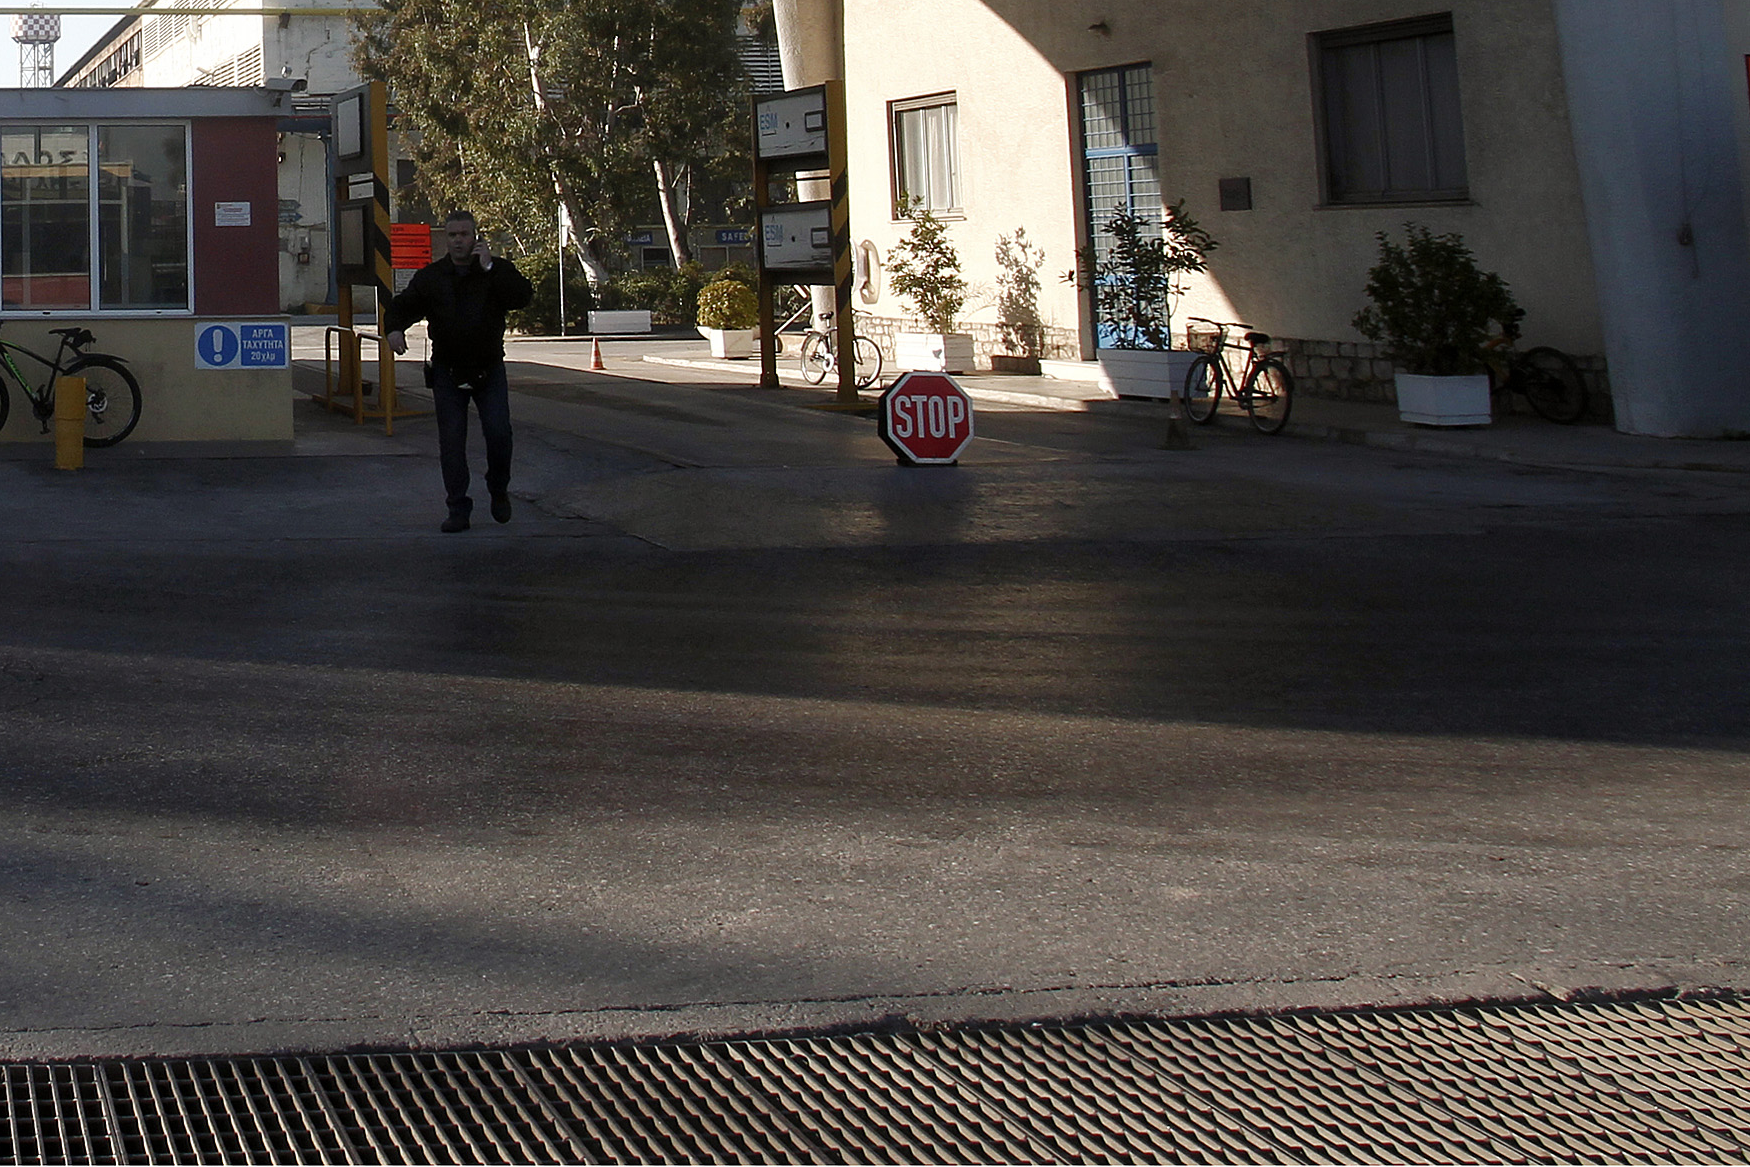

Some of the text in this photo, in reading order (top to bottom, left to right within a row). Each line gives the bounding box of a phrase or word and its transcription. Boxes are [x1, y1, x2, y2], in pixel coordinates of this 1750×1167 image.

[252, 329, 274, 338] ΑΡΓΑ
[242, 340, 284, 349] ΤΑΧΥΤΗΤΑ
[895, 395, 964, 439] STOP
